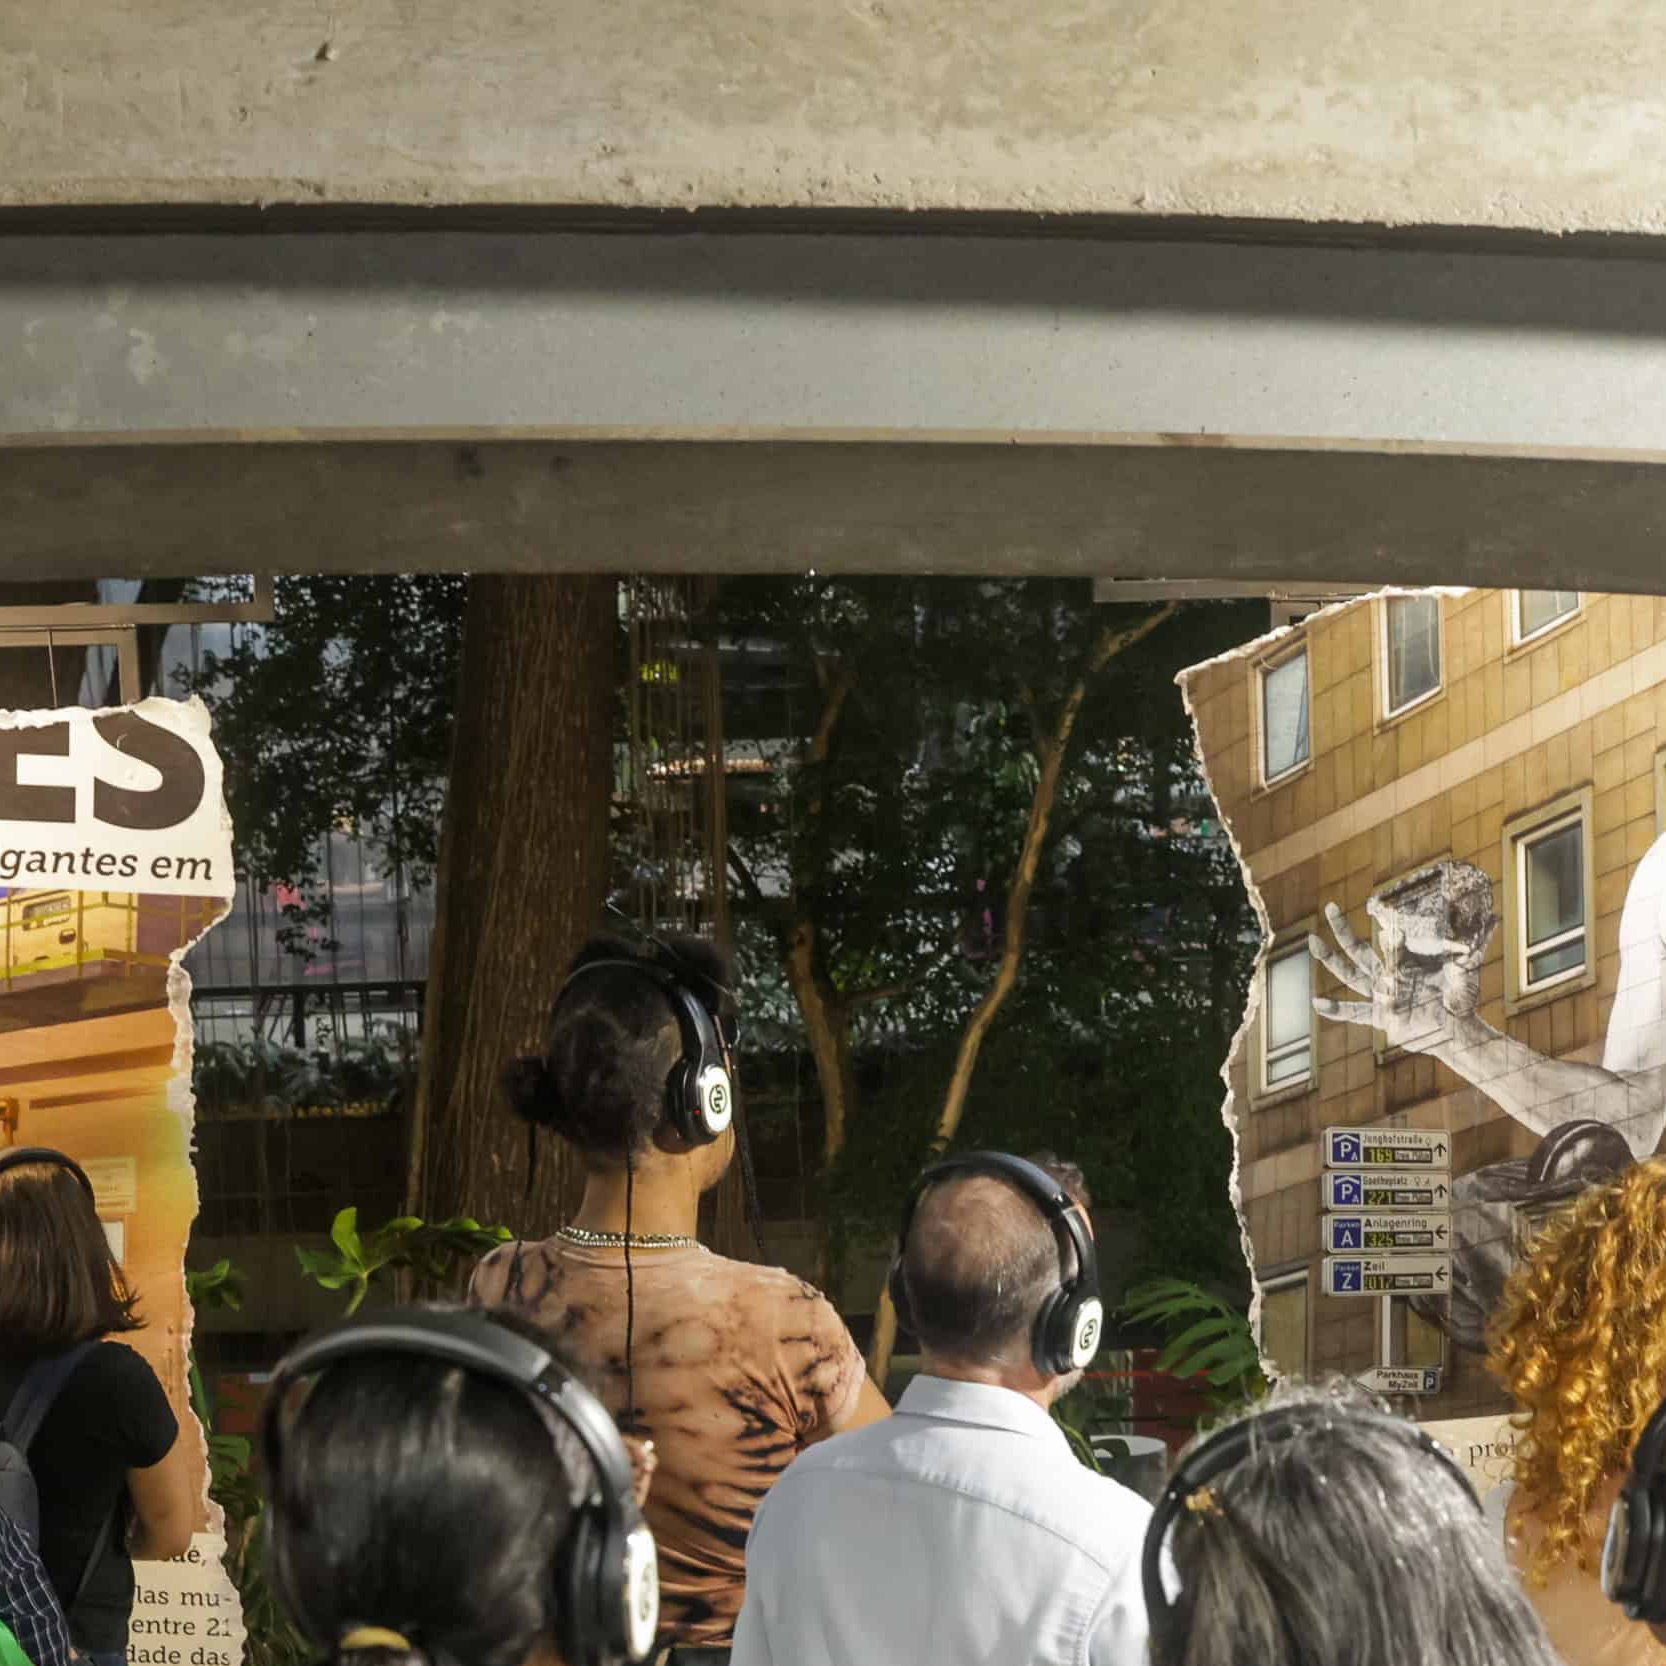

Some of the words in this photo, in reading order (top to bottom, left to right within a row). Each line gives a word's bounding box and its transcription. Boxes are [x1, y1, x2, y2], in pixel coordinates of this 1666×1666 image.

[149, 855, 214, 881] em
[180, 1591, 233, 1607] mu-
[131, 1617, 196, 1636] entre
[206, 1617, 233, 1637] 21
[190, 1647, 230, 1666] das
